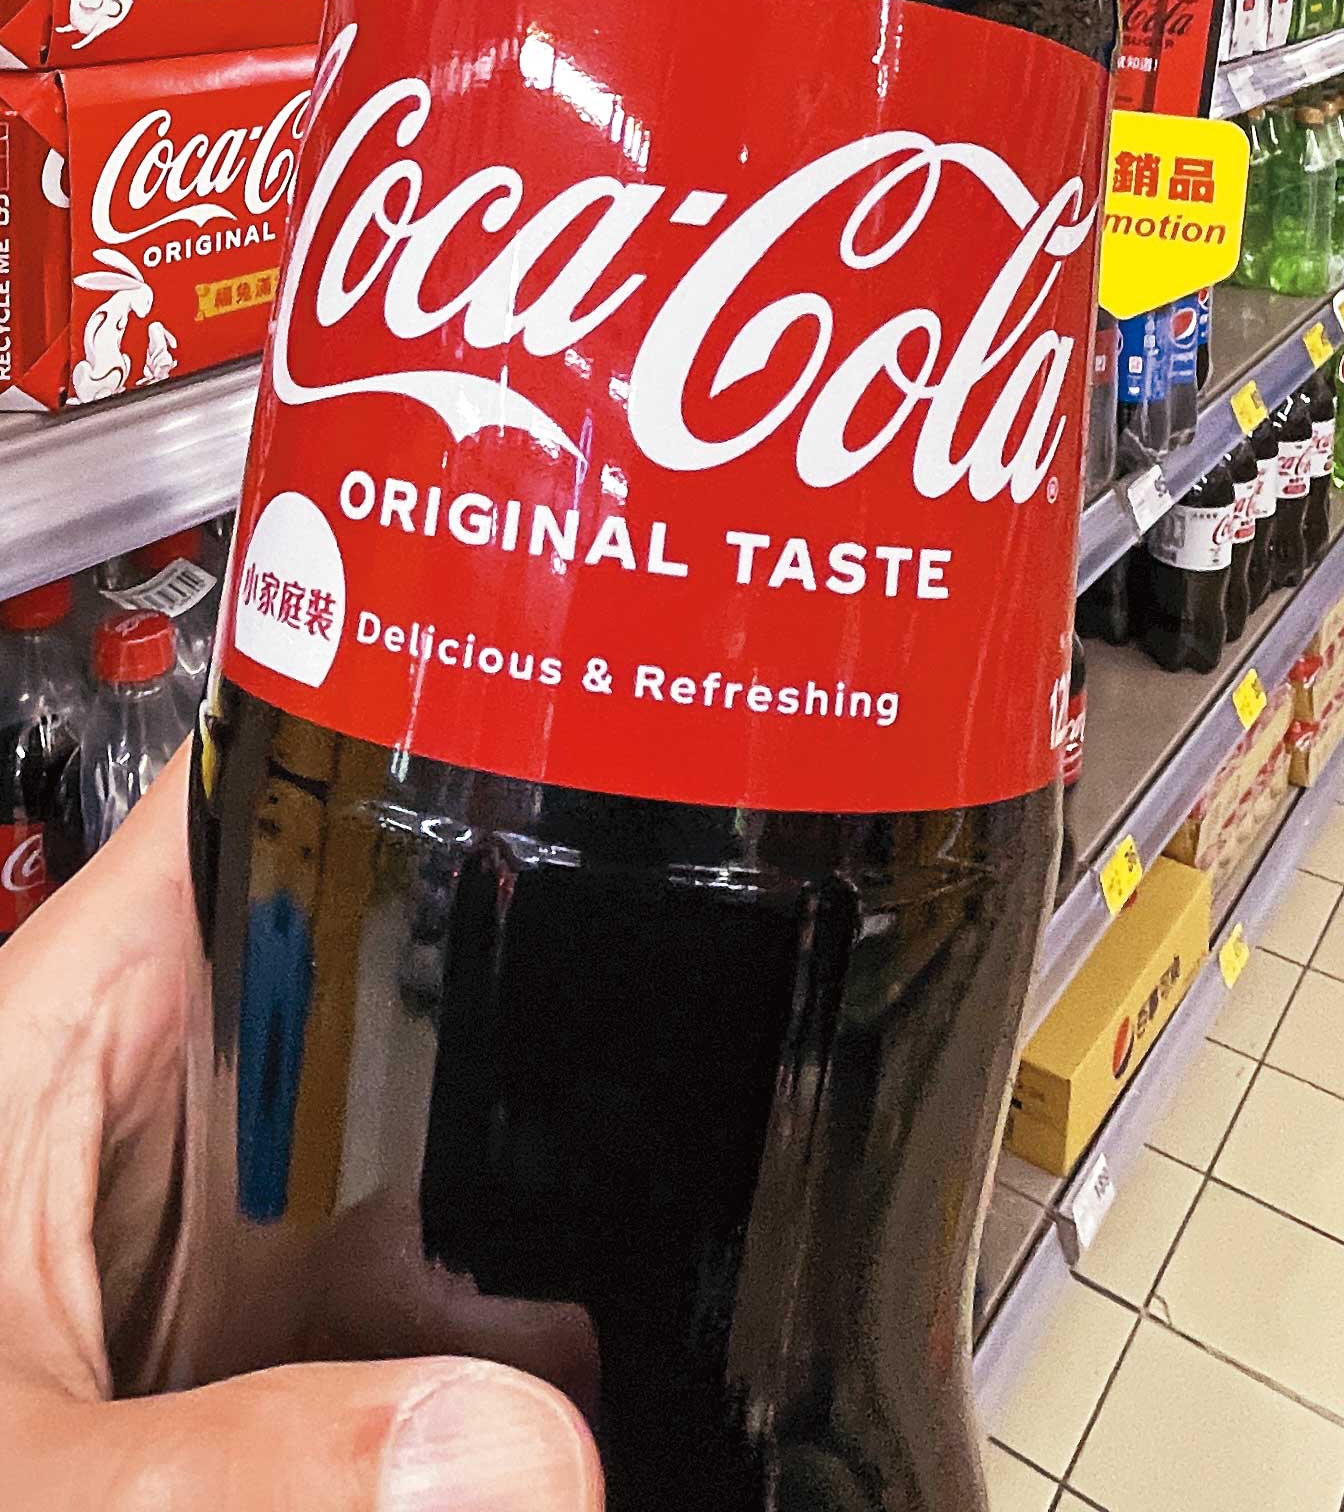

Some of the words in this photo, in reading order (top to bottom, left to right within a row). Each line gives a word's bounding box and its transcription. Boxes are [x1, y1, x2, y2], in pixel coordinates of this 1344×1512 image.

[92, 89, 313, 245] Coca-C
[1112, 150, 1215, 204] 銷品
[142, 221, 277, 269] ORIGINAL
[1105, 212, 1227, 245] motion
[272, 78, 1098, 503] Coca-Cola
[340, 470, 689, 577] ORIGINAL
[725, 530, 953, 600] TASTE
[356, 609, 562, 687] Delicious
[582, 656, 613, 694] &
[635, 665, 900, 726] Refreshing
